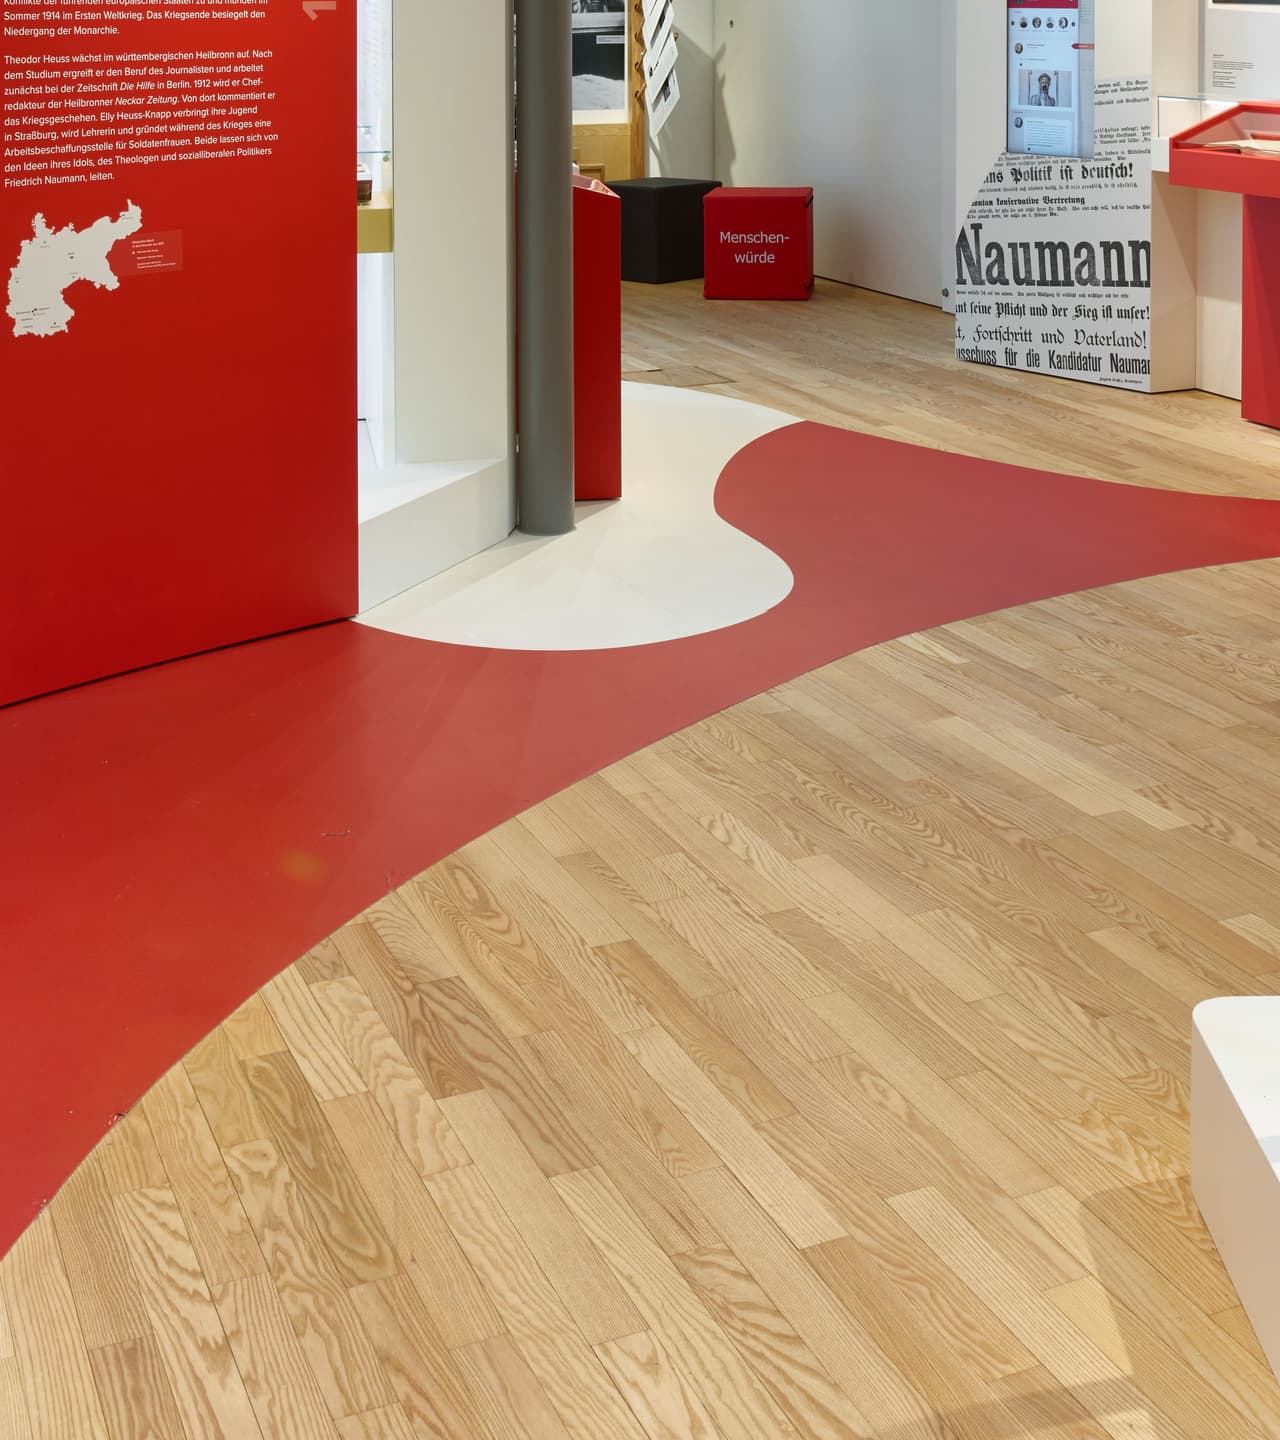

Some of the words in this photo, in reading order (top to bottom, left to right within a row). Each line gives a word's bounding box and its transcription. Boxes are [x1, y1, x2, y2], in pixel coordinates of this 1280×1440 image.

[3, 54, 41, 64] Theodor
[42, 54, 70, 63] Heuss
[71, 53, 102, 62] wächst
[103, 53, 114, 61] im
[114, 51, 194, 63] württembergischen
[195, 50, 235, 59] Heilbronn
[252, 49, 273, 58] Nach
[3, 70, 24, 79] dem
[25, 69, 61, 79] Studium
[62, 68, 94, 80] ergreift
[106, 67, 122, 76] den
[124, 67, 147, 76] Beruf
[148, 66, 164, 75] des
[164, 65, 214, 74] Journalisten
[215, 64, 232, 73] und
[232, 63, 264, 73] arbeitet
[4, 176, 42, 187] Friedrich
[1010, 165, 1052, 184] Politik
[720, 231, 790, 244] Menschen-
[734, 250, 775, 264] würde
[995, 302, 1026, 319] Pflicht
[1029, 303, 1048, 317] und
[1051, 303, 1069, 317] der
[1072, 304, 1098, 321] Sieg
[1041, 328, 1065, 345] und
[1073, 328, 1147, 350] Vaterland!
[1004, 346, 1018, 366] für
[1026, 348, 1041, 368] die
[1048, 349, 1102, 372] Kandidatur
